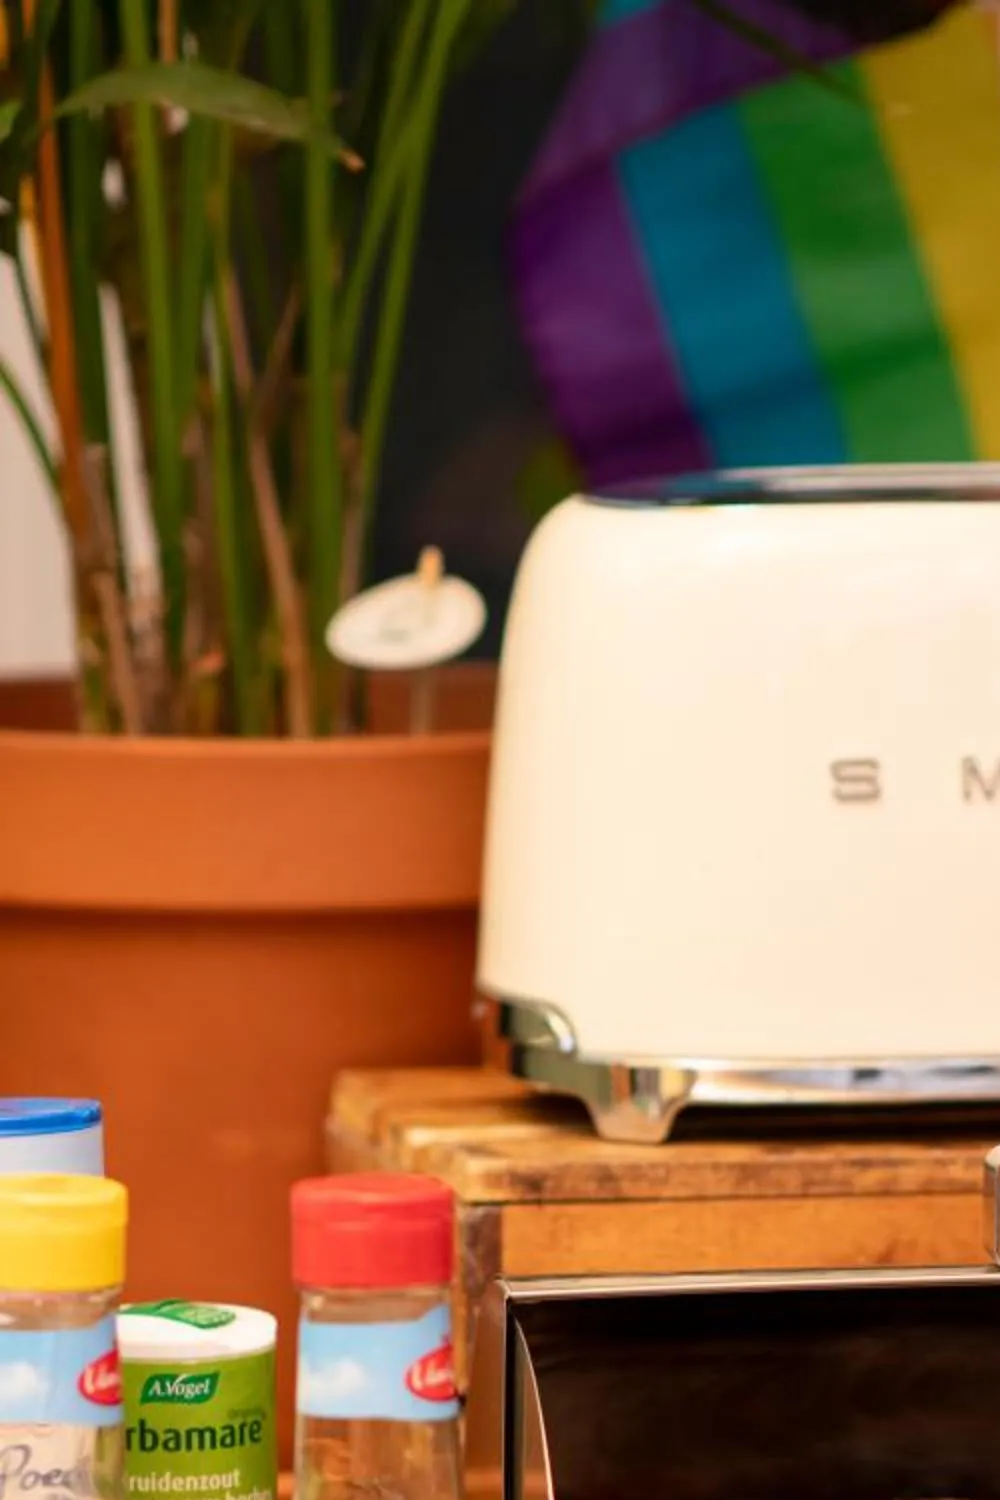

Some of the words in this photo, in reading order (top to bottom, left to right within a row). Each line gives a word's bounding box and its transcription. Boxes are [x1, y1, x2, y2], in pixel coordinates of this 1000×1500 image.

[148, 1373, 211, 1399] A.Vogel
[125, 1418, 262, 1453] rbamare
[129, 1469, 240, 1493] ruidenzout
